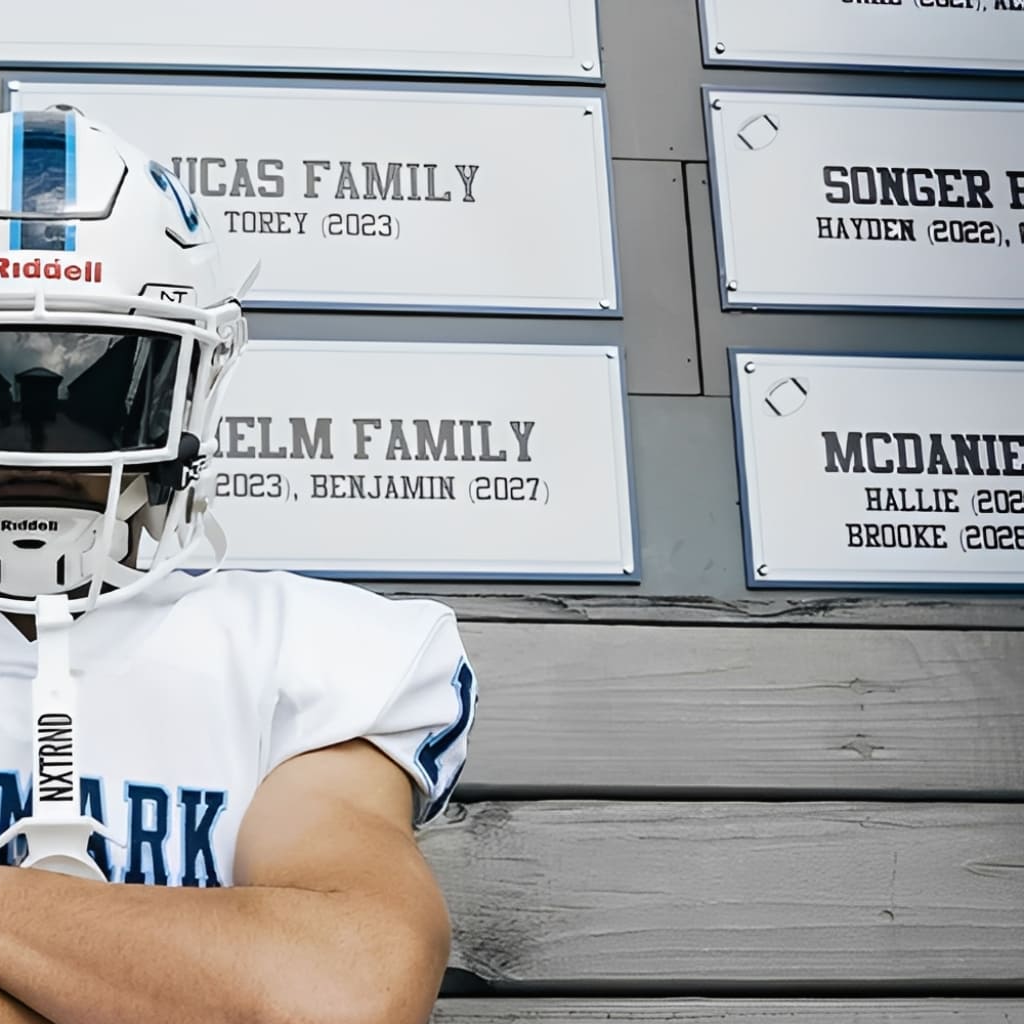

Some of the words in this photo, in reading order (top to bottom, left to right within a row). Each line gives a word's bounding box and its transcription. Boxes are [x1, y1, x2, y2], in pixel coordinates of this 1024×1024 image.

[302, 160, 480, 203] FAMILY
[823, 166, 994, 209] SONGER
[224, 210, 308, 235] TOREY
[321, 212, 401, 240] (2023)
[816, 216, 917, 242] HAYDEN
[927, 220, 1011, 248] (2022),
[213, 416, 334, 460] ELM
[352, 418, 535, 462] FAMILY
[821, 431, 1024, 477] MCDANIE
[310, 474, 456, 500] BENJAMIN
[468, 475, 550, 505] (2027)
[864, 487, 960, 513] HALLIE
[845, 523, 948, 549] BROOKE
[37, 713, 74, 802] NXTRND
